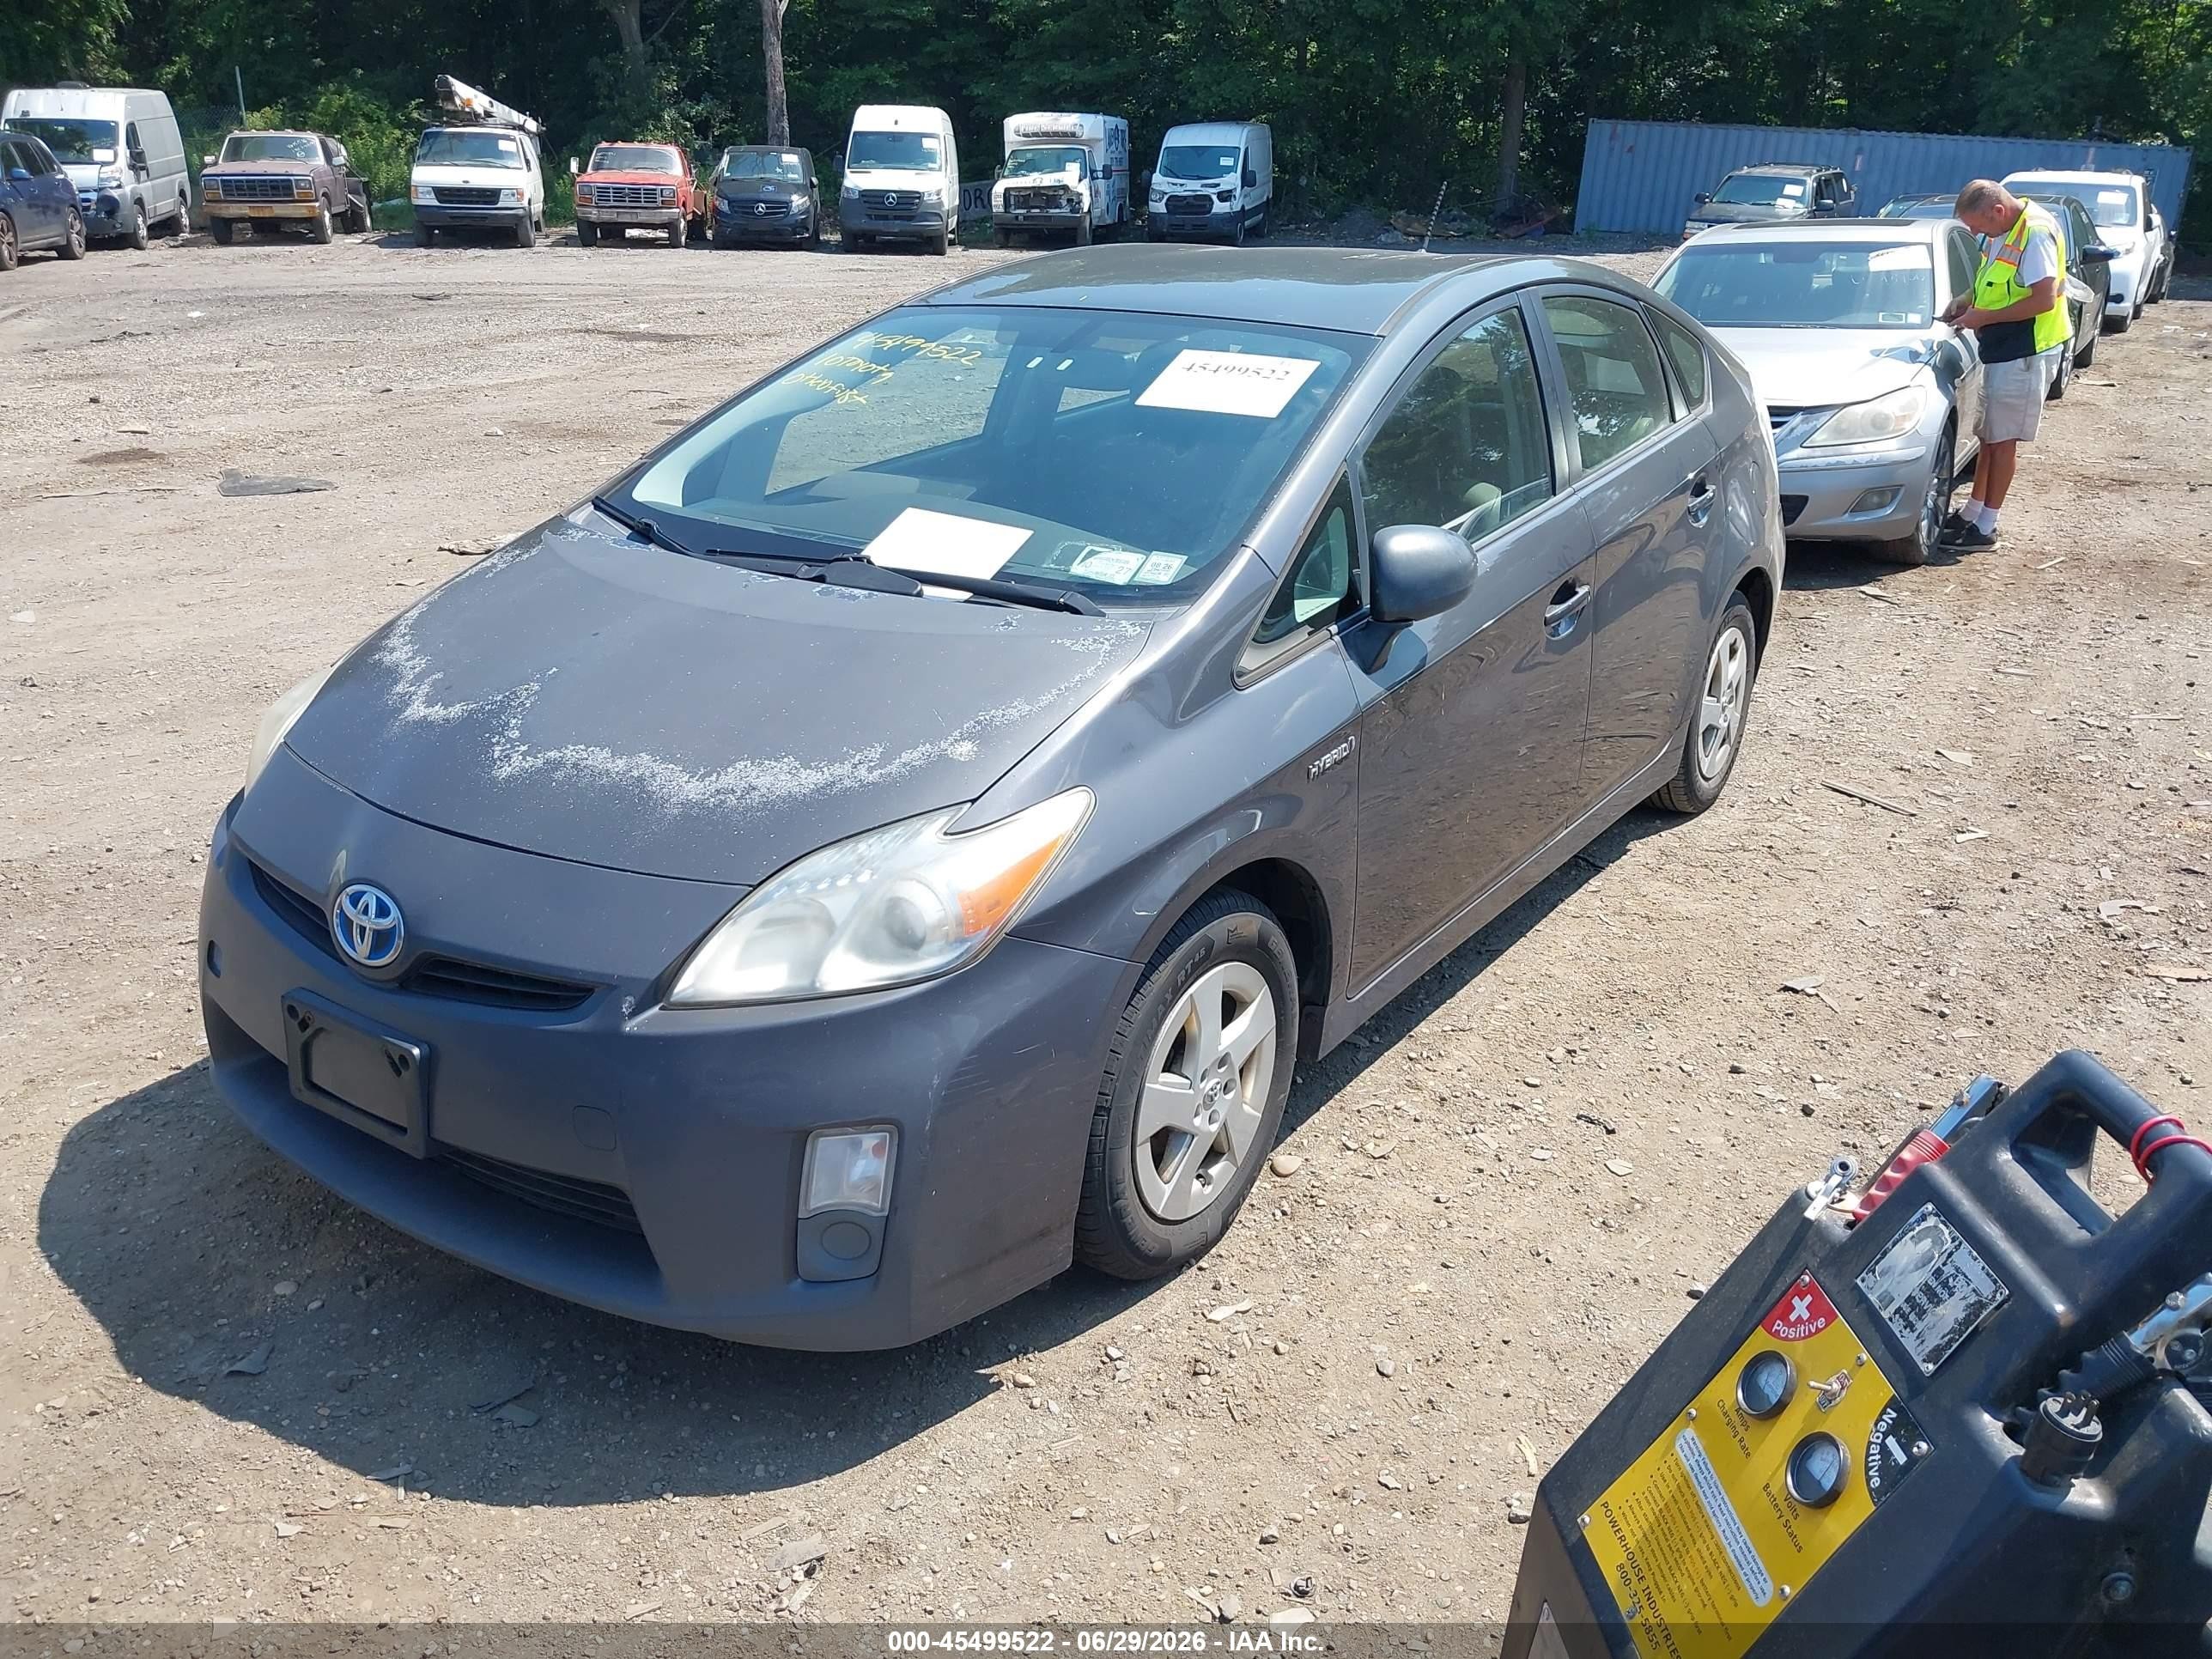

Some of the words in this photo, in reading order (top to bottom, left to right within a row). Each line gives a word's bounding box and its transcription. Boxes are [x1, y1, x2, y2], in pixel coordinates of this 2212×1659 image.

[1182, 362, 1291, 380] 45499522
[1308, 739, 1354, 781] HYBRID
[1771, 1316, 1826, 1338] Positive
[1717, 1399, 1740, 1439] Charging
[1738, 1434, 1751, 1459] Rate
[1735, 1407, 1750, 1431] Amps
[1868, 1407, 1897, 1488] Negative
[1763, 1482, 1784, 1520] Battery
[1783, 1519, 1803, 1553] Status
[1784, 1493, 1799, 1520] Volts
[1601, 1501, 1645, 1584] POWERHOUSE
[1616, 1563, 1661, 1650] 800-325-5855
